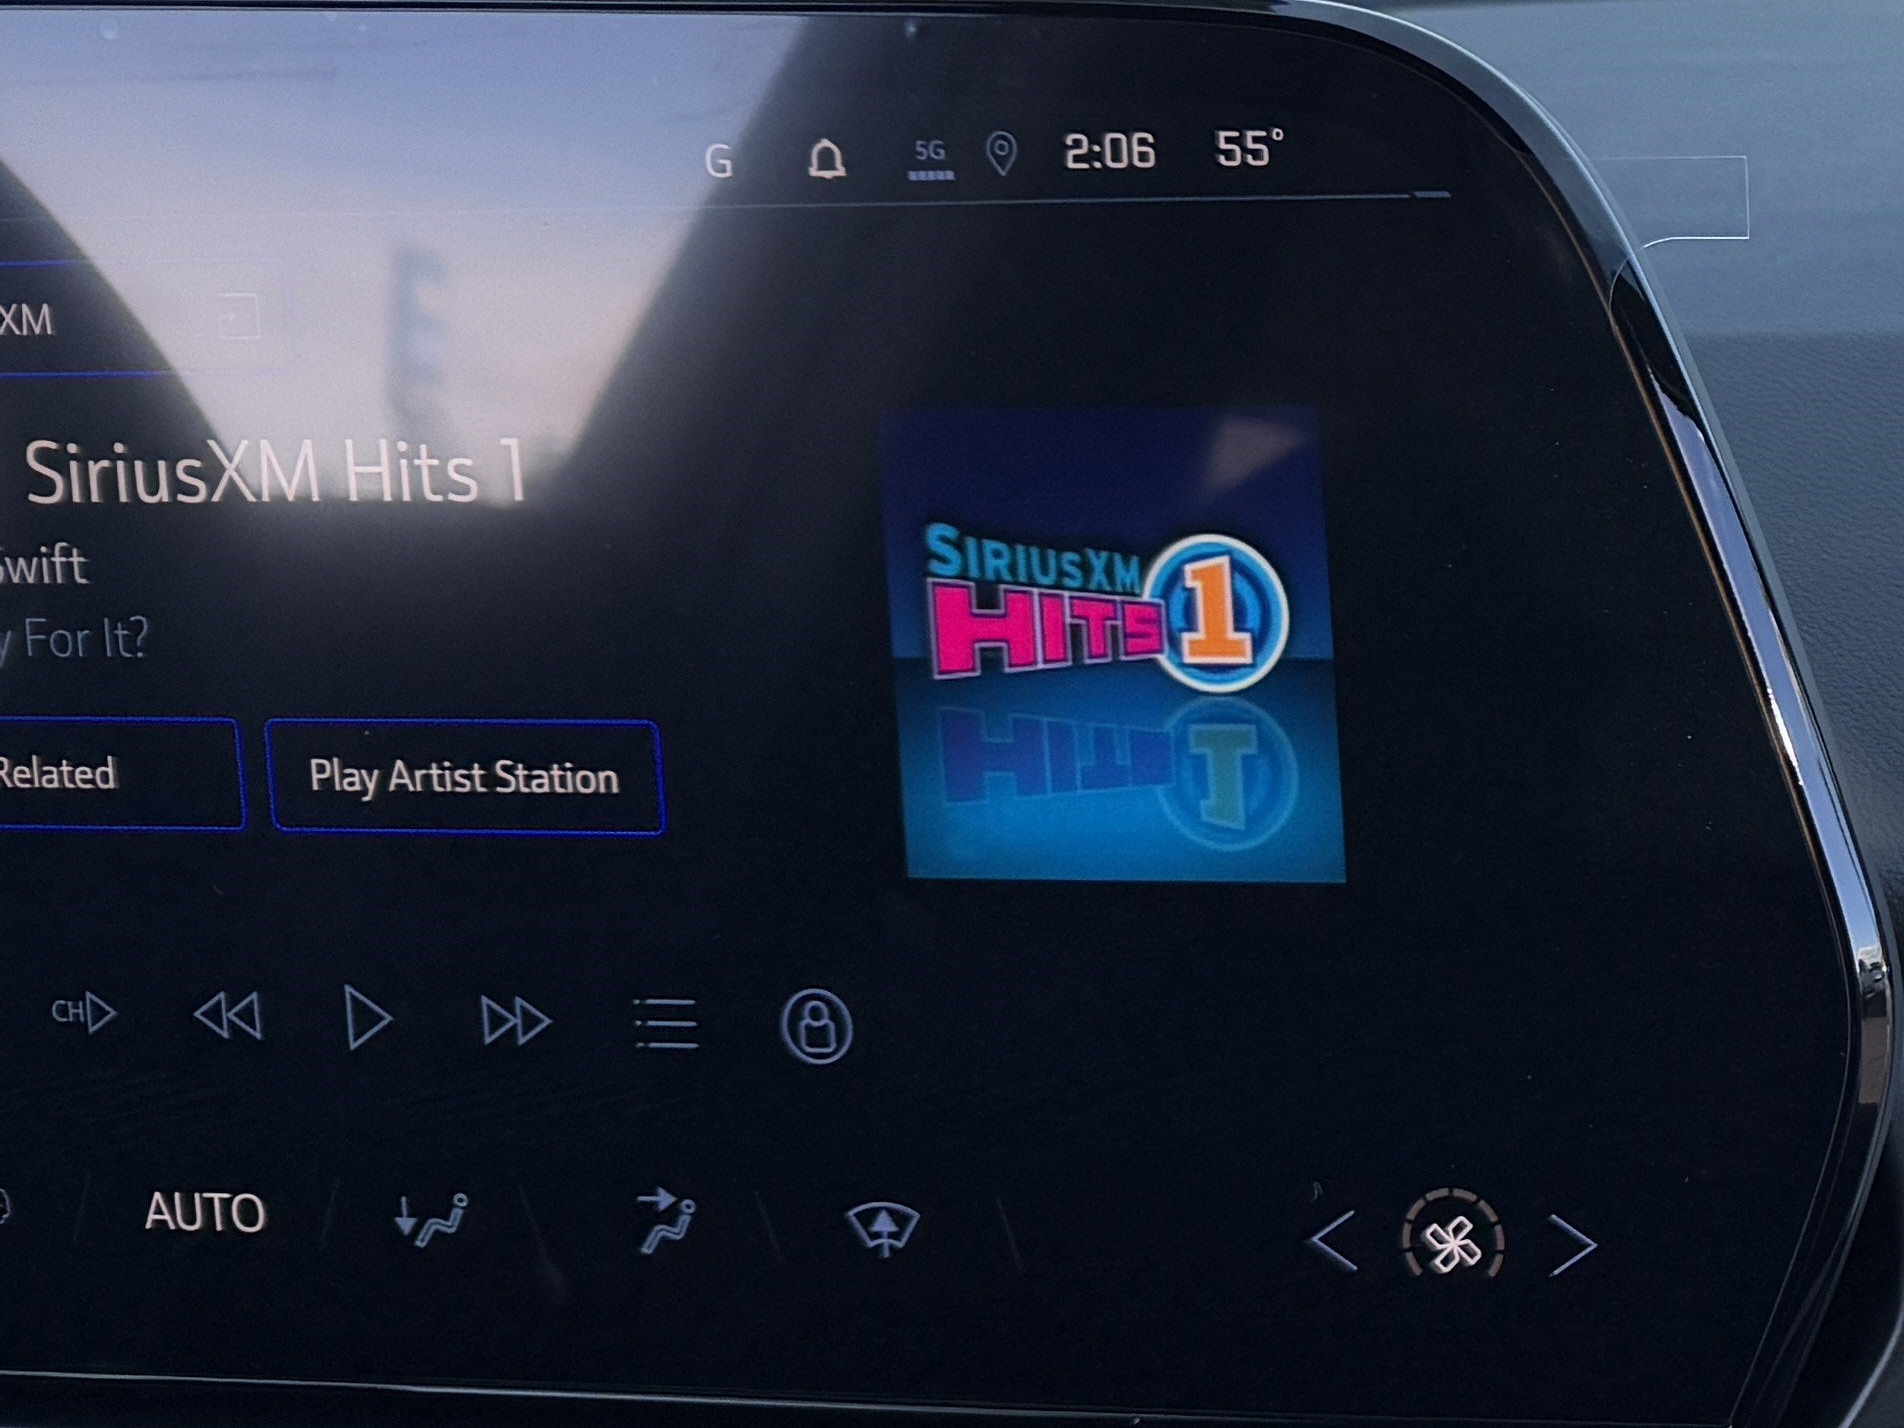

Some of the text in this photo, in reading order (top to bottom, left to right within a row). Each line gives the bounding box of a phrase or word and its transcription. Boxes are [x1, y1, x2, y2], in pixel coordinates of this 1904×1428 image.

[705, 127, 1284, 178] G 5G 2:06 55°
[26, 438, 525, 504] SiriusXM Hits 1
[0, 542, 92, 584] wift
[25, 618, 91, 658] For
[104, 615, 149, 658] It?
[928, 555, 1253, 679] HITS 1
[311, 757, 620, 802] Play Artist Station
[52, 1000, 84, 1022] CH
[145, 1191, 266, 1233] AUTO
